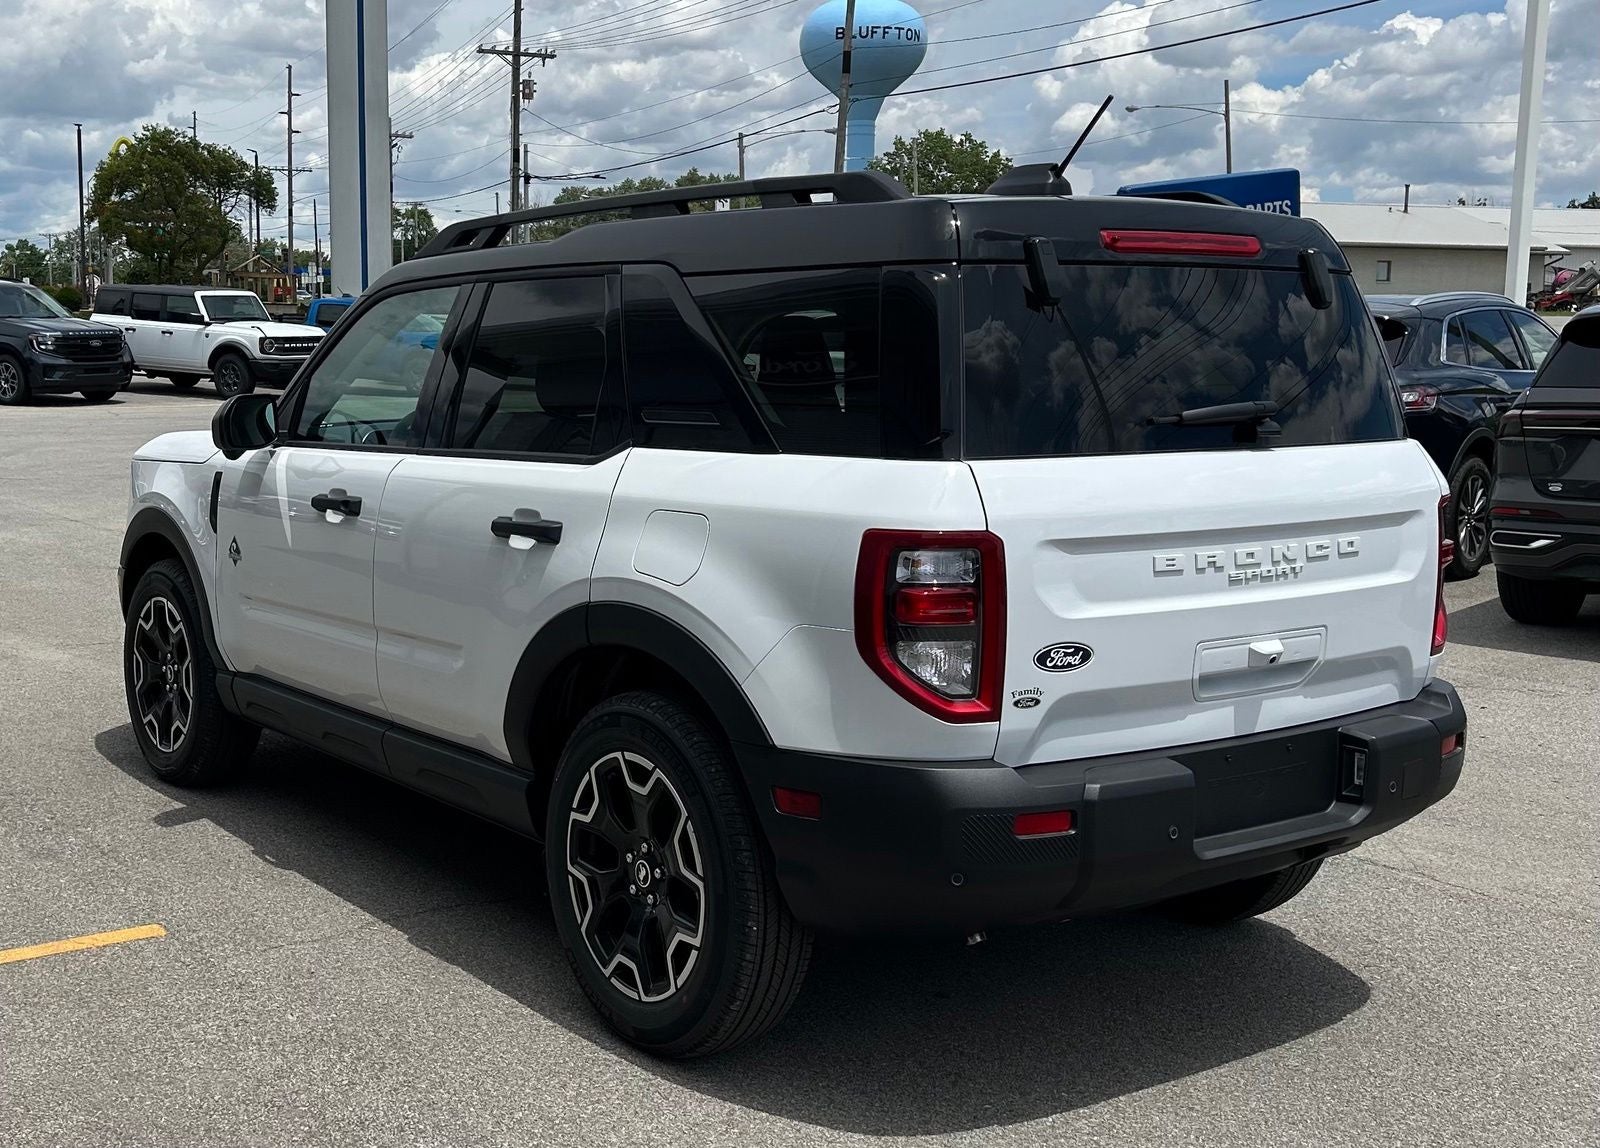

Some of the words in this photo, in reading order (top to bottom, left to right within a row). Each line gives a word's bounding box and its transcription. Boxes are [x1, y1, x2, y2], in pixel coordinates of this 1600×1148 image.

[835, 25, 920, 42] BUFFTON
[1153, 537, 1361, 577] BRONCO
[1228, 564, 1304, 586] SPORT
[1045, 647, 1085, 668] Ford
[1011, 687, 1044, 698] Family
[1016, 698, 1038, 708] Ford
